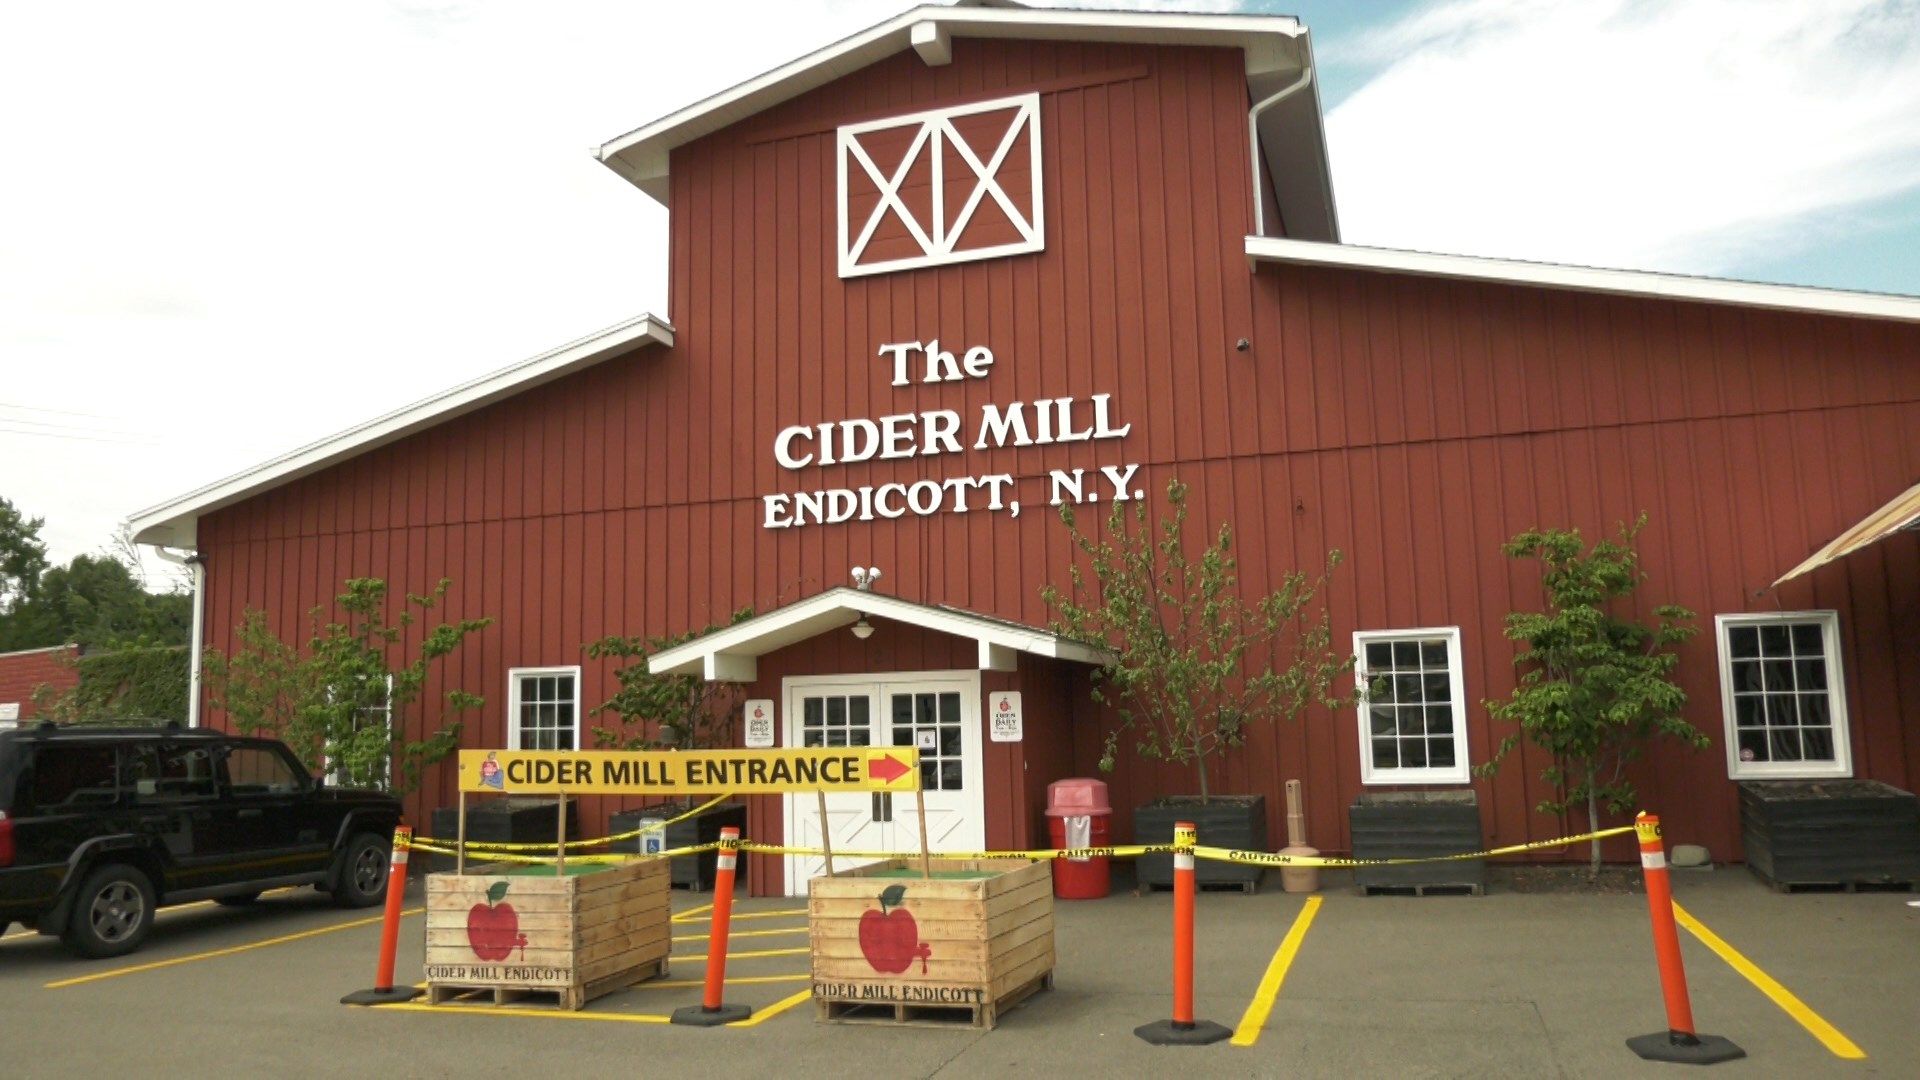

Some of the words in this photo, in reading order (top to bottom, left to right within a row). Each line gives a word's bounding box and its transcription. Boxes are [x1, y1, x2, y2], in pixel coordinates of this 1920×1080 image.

[878, 339, 994, 386] The
[774, 409, 962, 470] CIDER
[974, 393, 1131, 449] MILL
[763, 474, 1020, 528] ENDICOTT,
[1049, 464, 1144, 506] N.Y.
[507, 758, 593, 785] CIDER
[603, 760, 676, 786] MILL
[687, 756, 861, 785] ENTRANCE
[1057, 848, 1115, 858] CAUTION
[1229, 850, 1292, 864] CAUTION
[427, 966, 466, 978] CIDER
[470, 967, 501, 980] MILL
[504, 968, 572, 981] ENDICOTT
[813, 983, 857, 998] CIDER
[862, 984, 898, 1000] MILL
[902, 985, 985, 1002] ENDICOTT
